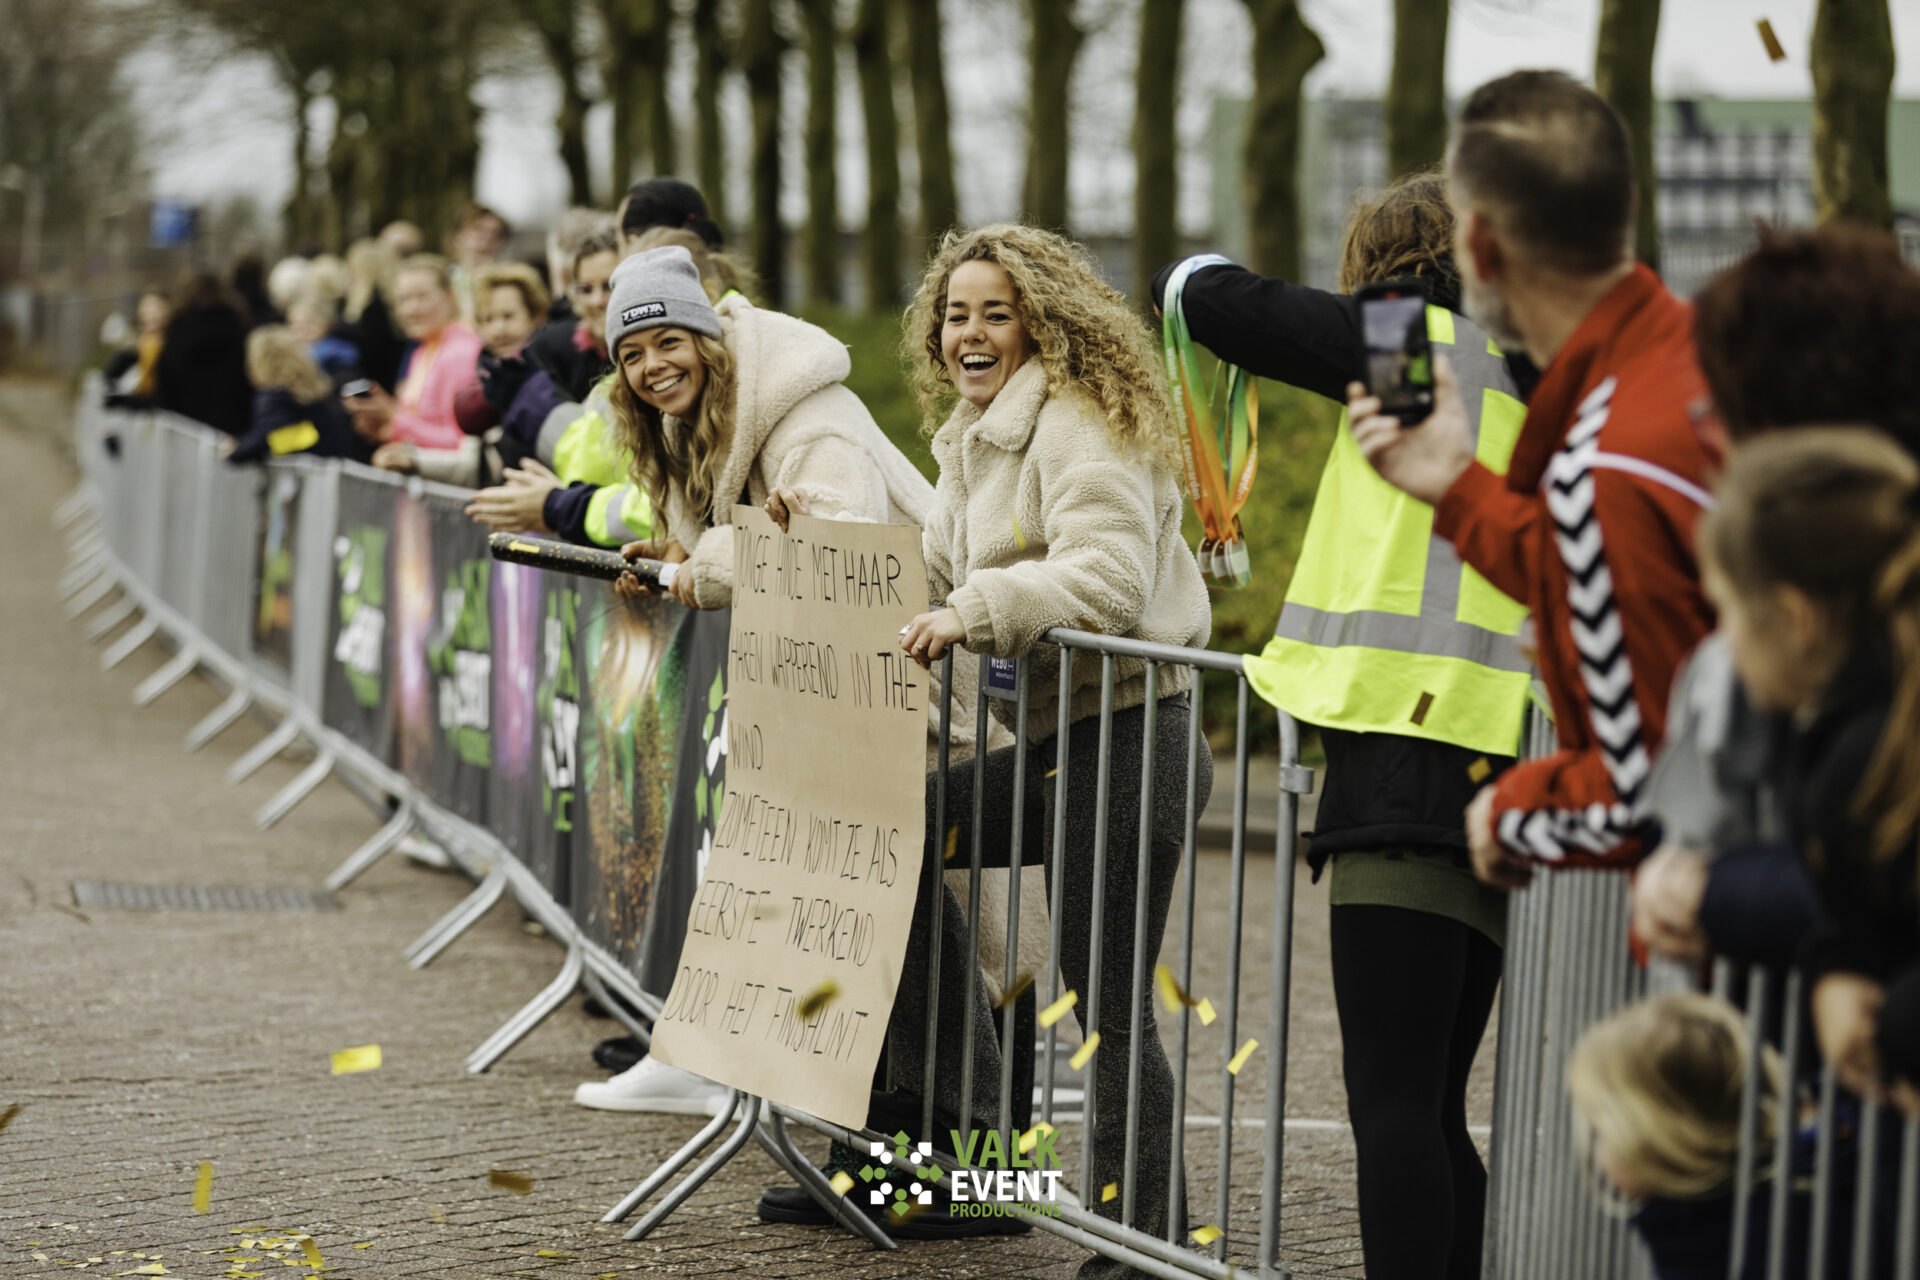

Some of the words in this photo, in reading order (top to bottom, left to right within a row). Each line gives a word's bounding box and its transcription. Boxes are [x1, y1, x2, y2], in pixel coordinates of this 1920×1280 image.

[733, 525, 770, 608] JONGE
[812, 542, 838, 604] MET
[843, 549, 903, 609] HAAR
[731, 630, 763, 685] HAREN
[850, 652, 872, 709] IN
[877, 651, 918, 711] THE
[730, 720, 764, 771] WIND
[715, 791, 798, 866] ZOMETEEN
[803, 811, 841, 874] KOMT
[841, 824, 863, 880] ZE
[866, 825, 900, 888] ALS
[693, 880, 771, 944] EERSTE
[786, 896, 874, 967] TWERKEND
[664, 966, 719, 1028] DOOR
[719, 979, 766, 1035] HET
